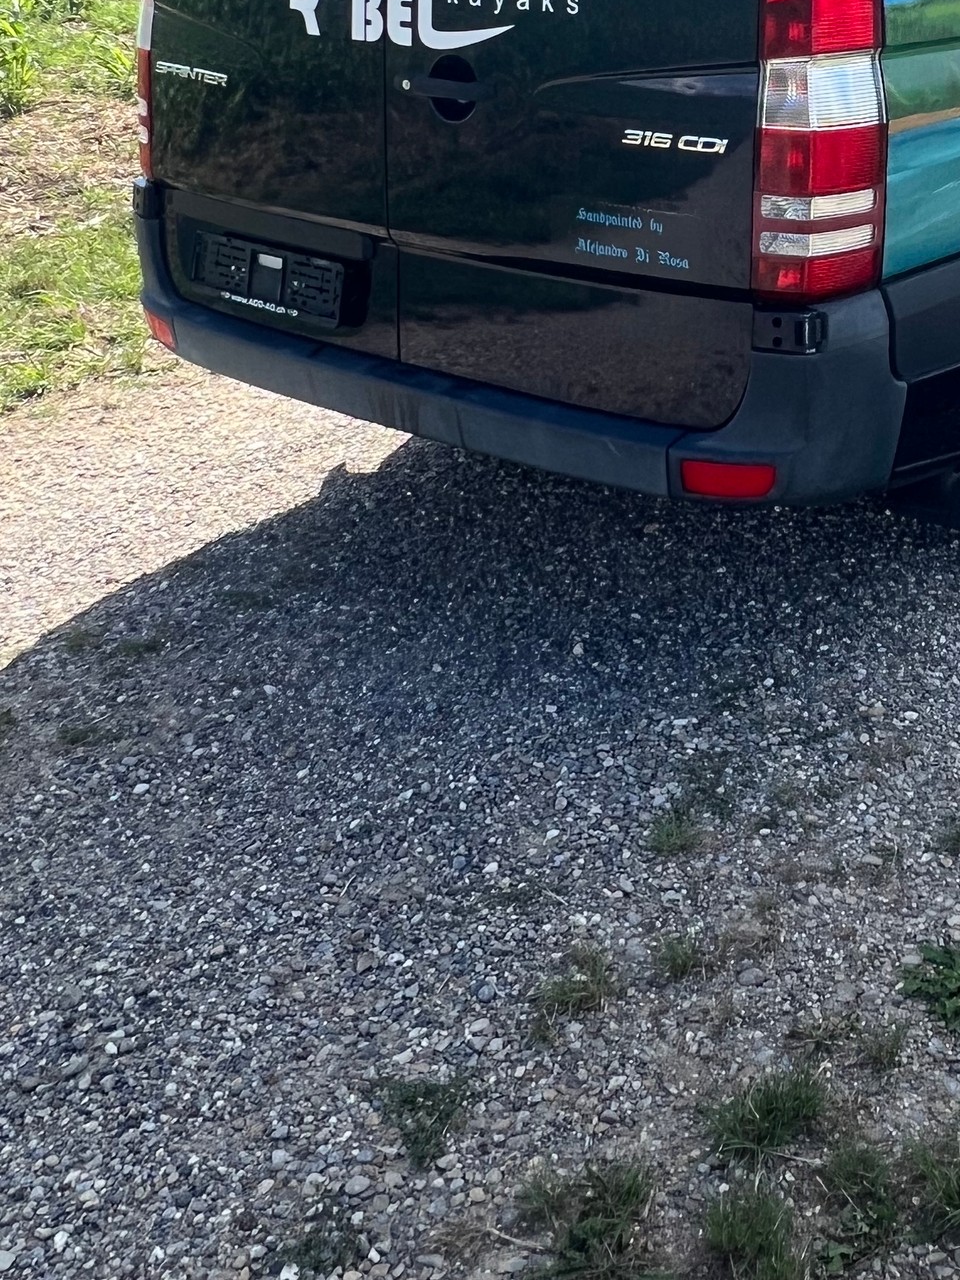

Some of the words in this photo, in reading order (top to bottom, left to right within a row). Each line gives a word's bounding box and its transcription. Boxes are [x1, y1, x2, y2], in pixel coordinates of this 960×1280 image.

[155, 61, 228, 87] SPRINTER
[621, 129, 673, 149] 316
[677, 135, 728, 154] CDI
[650, 218, 663, 235] by
[575, 237, 628, 259] Alejandro
[635, 246, 650, 264] Di
[657, 250, 690, 269] Rosa
